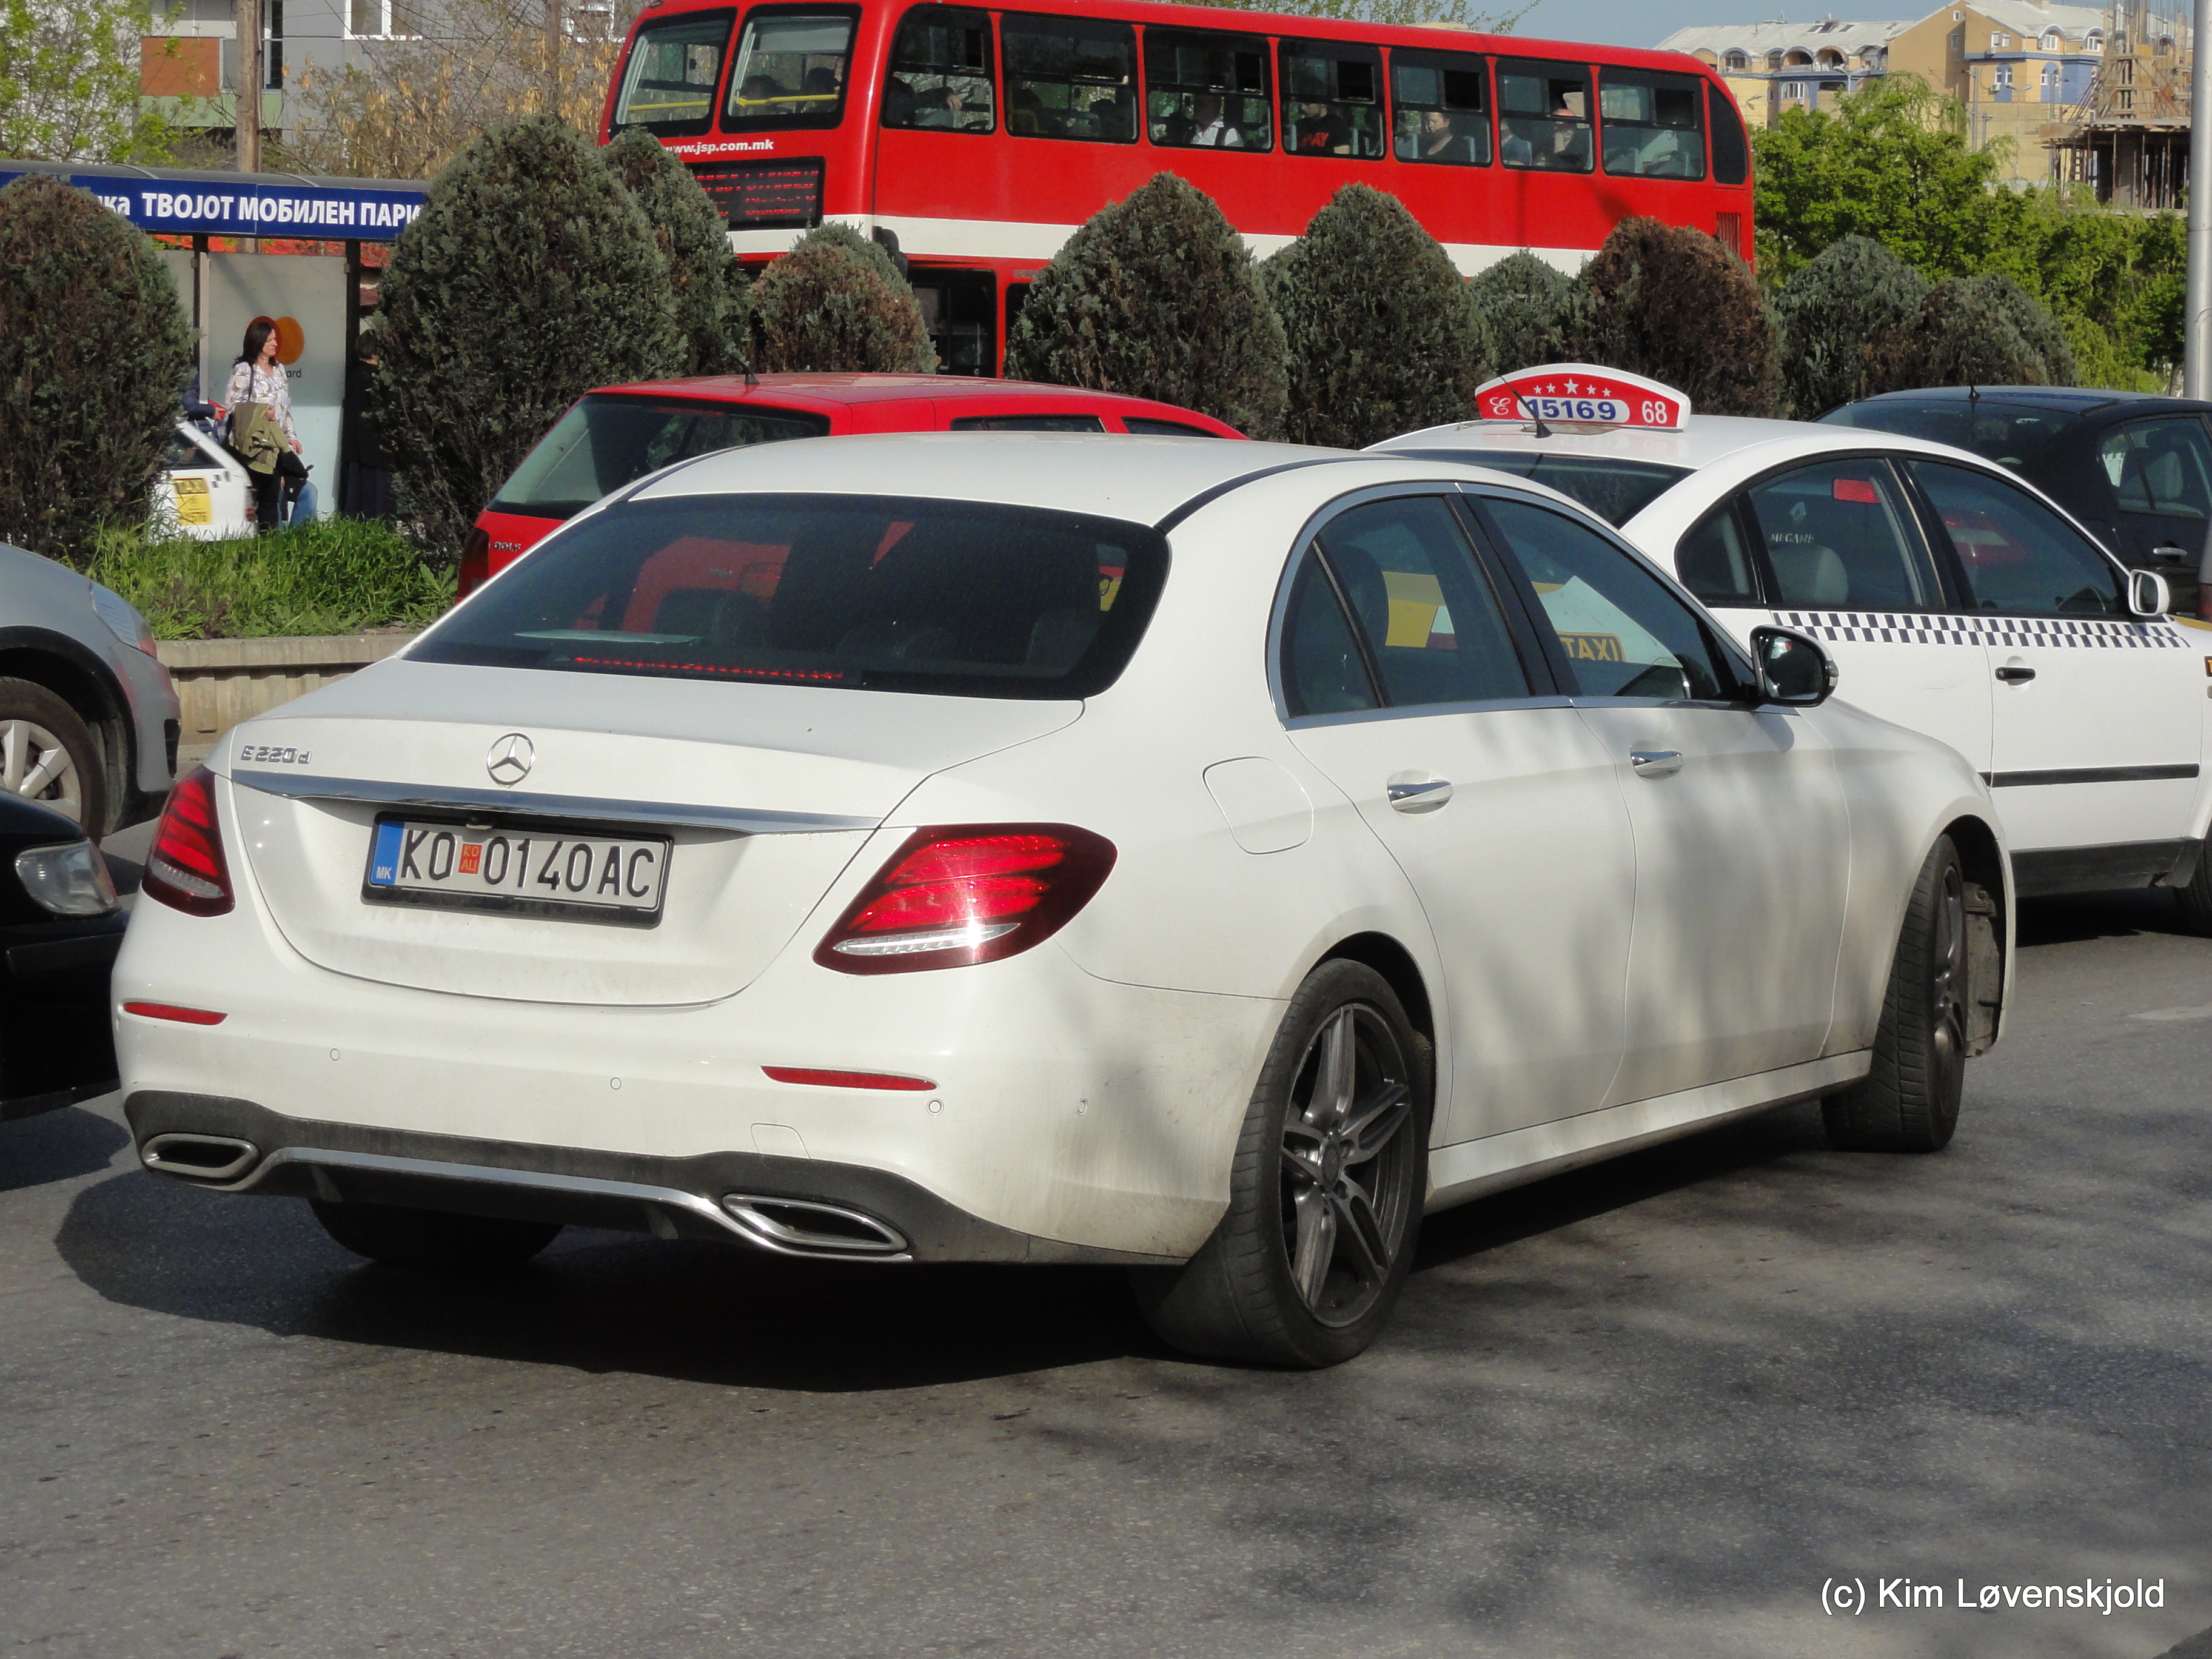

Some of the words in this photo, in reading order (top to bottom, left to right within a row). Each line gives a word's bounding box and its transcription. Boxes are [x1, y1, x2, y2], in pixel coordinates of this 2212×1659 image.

[142, 192, 234, 220] ТВОЈОТ
[239, 196, 355, 225] МОБИЛЕН
[1527, 399, 1617, 420] 15169
[1641, 401, 1667, 424] 68
[494, 541, 521, 552] GOLF
[1560, 637, 1618, 662] TAXI
[401, 830, 457, 881] KO
[375, 866, 391, 880] MK
